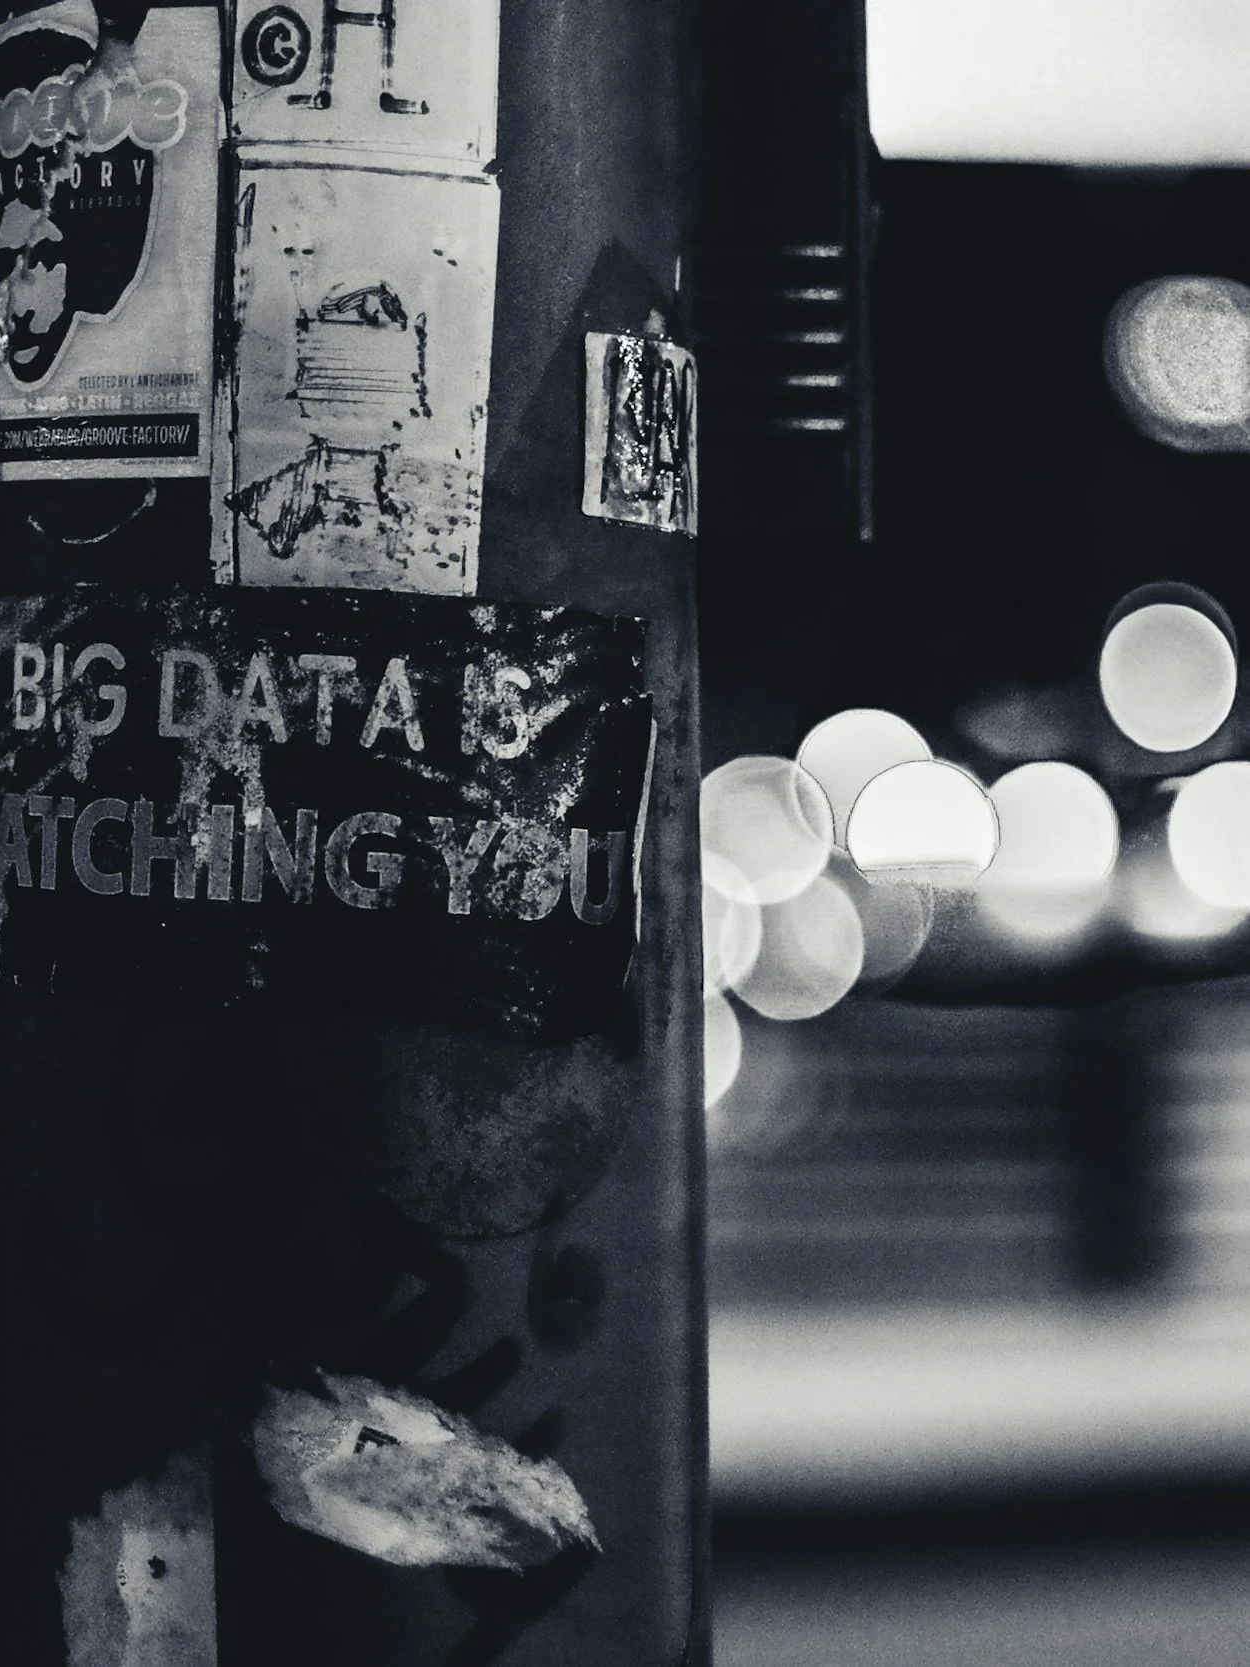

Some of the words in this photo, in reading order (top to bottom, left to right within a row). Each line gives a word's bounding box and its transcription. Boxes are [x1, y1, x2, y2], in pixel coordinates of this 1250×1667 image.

[13, 643, 127, 736] BIG
[159, 651, 424, 751] DATA
[461, 662, 532, 759] IS
[429, 817, 626, 924] YOU
